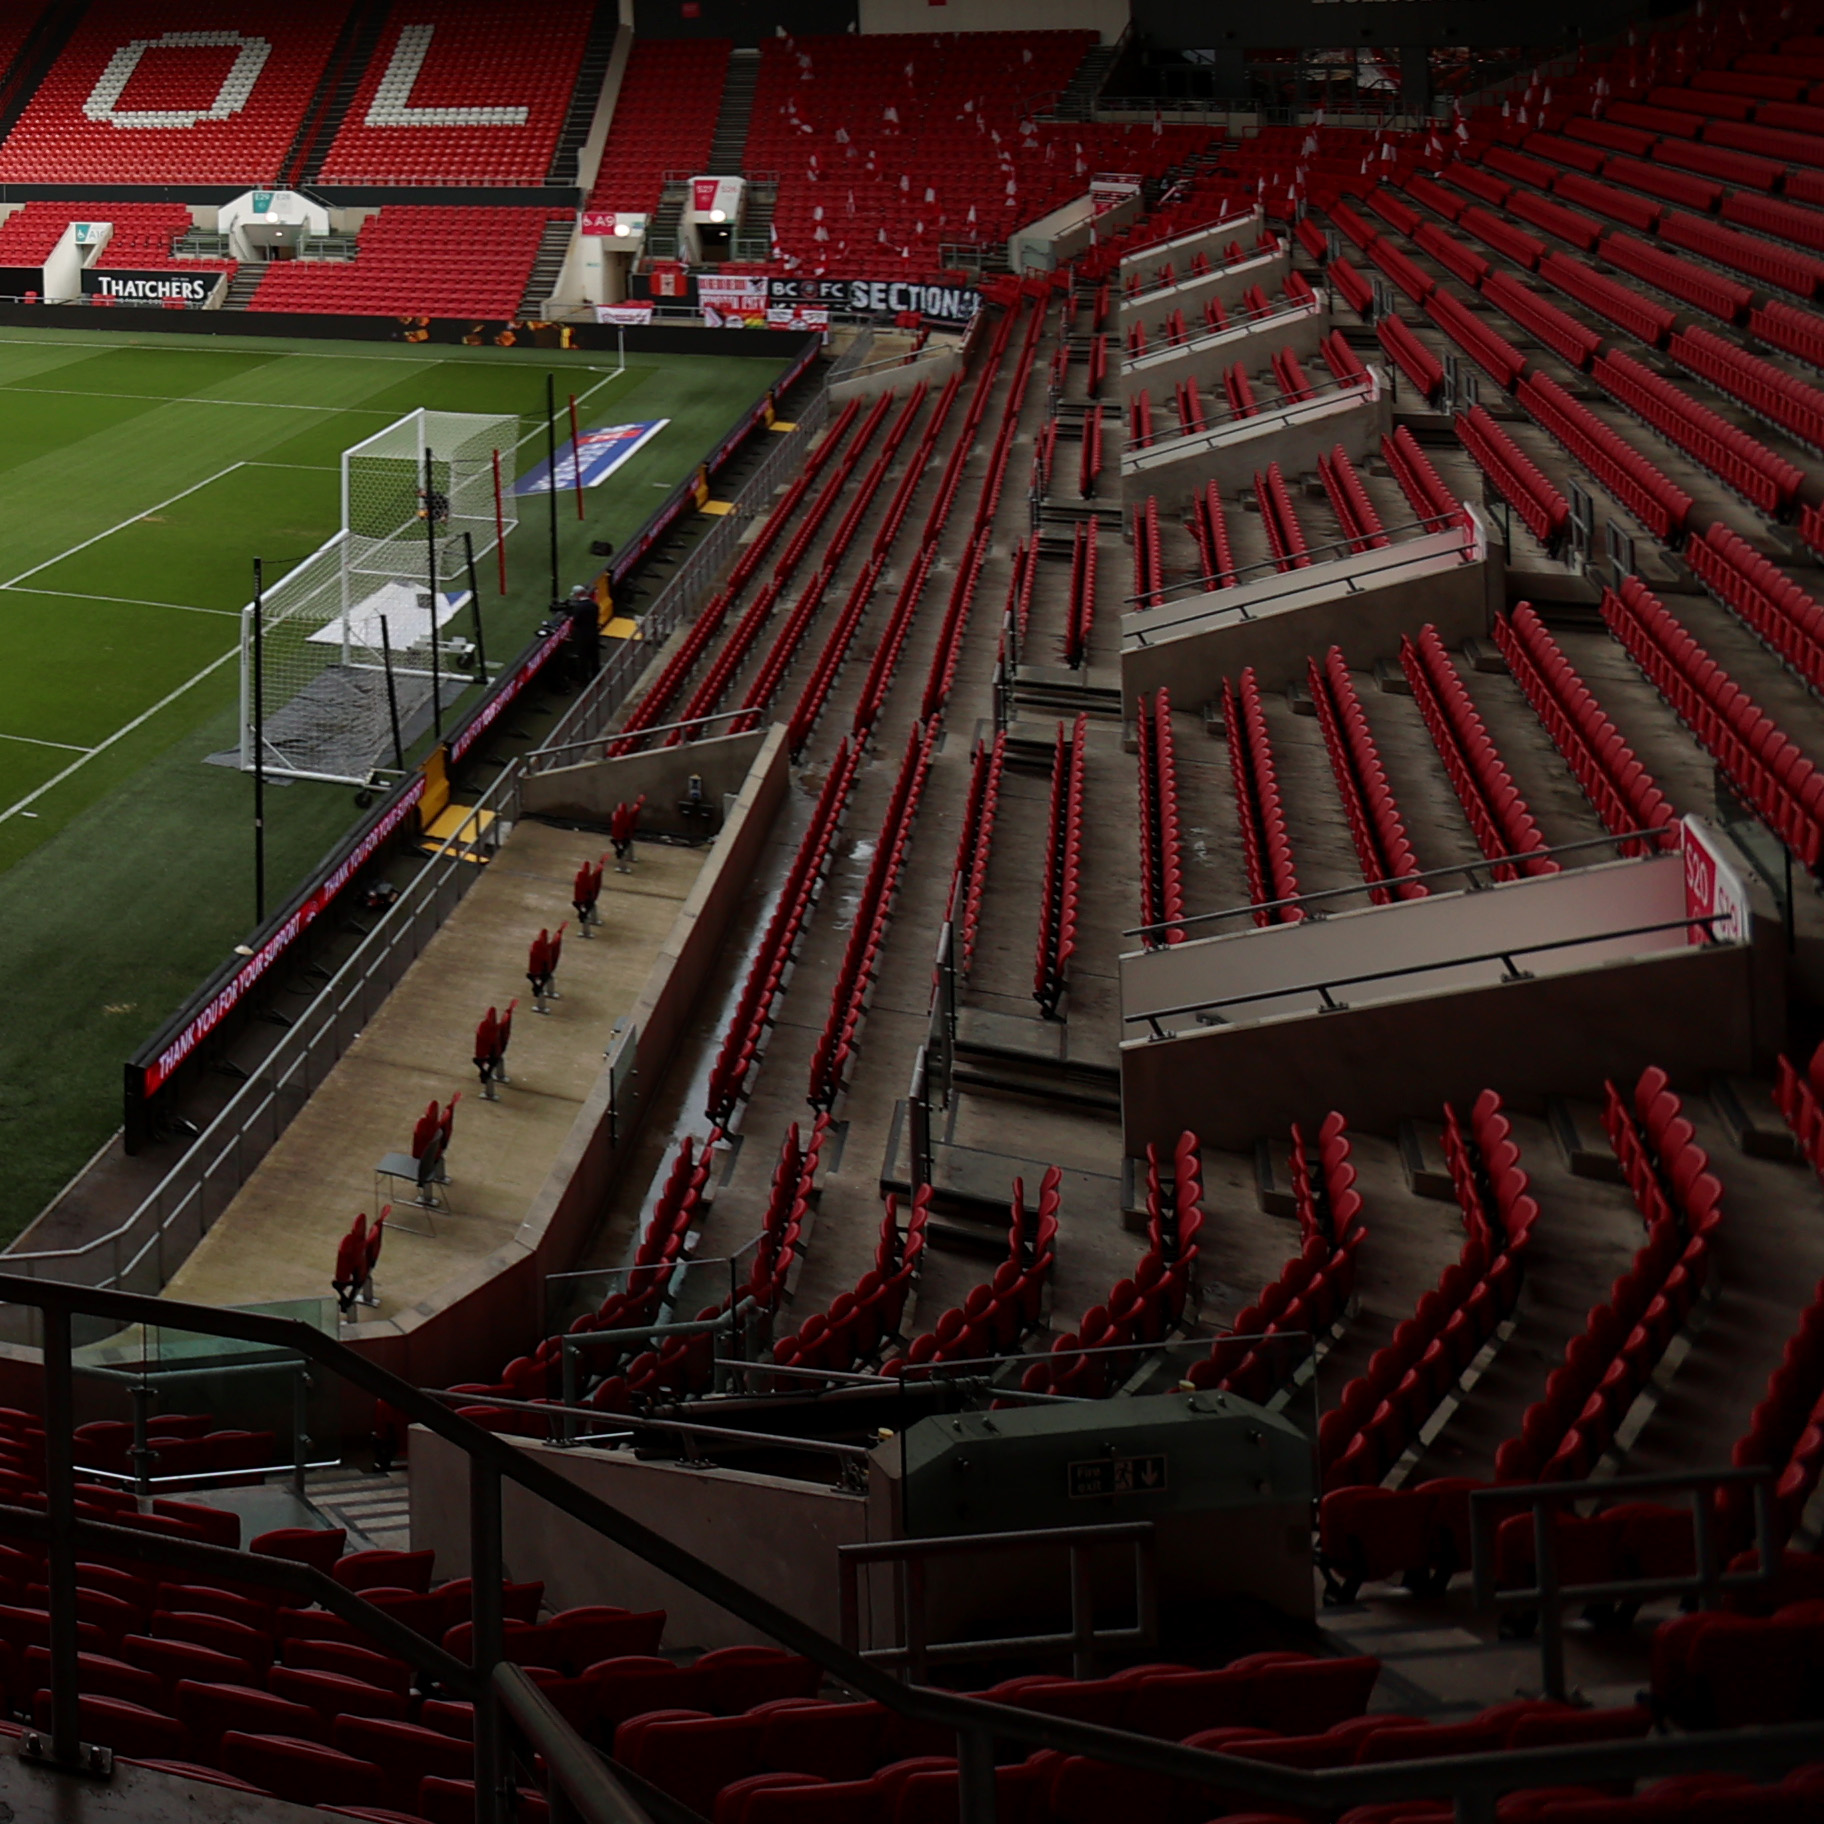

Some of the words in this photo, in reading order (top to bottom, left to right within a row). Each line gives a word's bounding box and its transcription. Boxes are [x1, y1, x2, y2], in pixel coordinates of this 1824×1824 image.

[255, 193, 270, 201] E29
[593, 216, 616, 227] A9
[98, 277, 205, 299] THATCHERS
[772, 282, 798, 297] BC
[820, 283, 845, 297] FC
[851, 280, 960, 319] SECTION
[1686, 843, 1708, 906] S20
[158, 1023, 196, 1080] THANK
[195, 999, 219, 1038] YOU
[218, 979, 239, 1016] FOR
[238, 952, 264, 994] YOUR
[263, 912, 302, 968] SUPPORT
[1077, 1465, 1102, 1480] Fire
